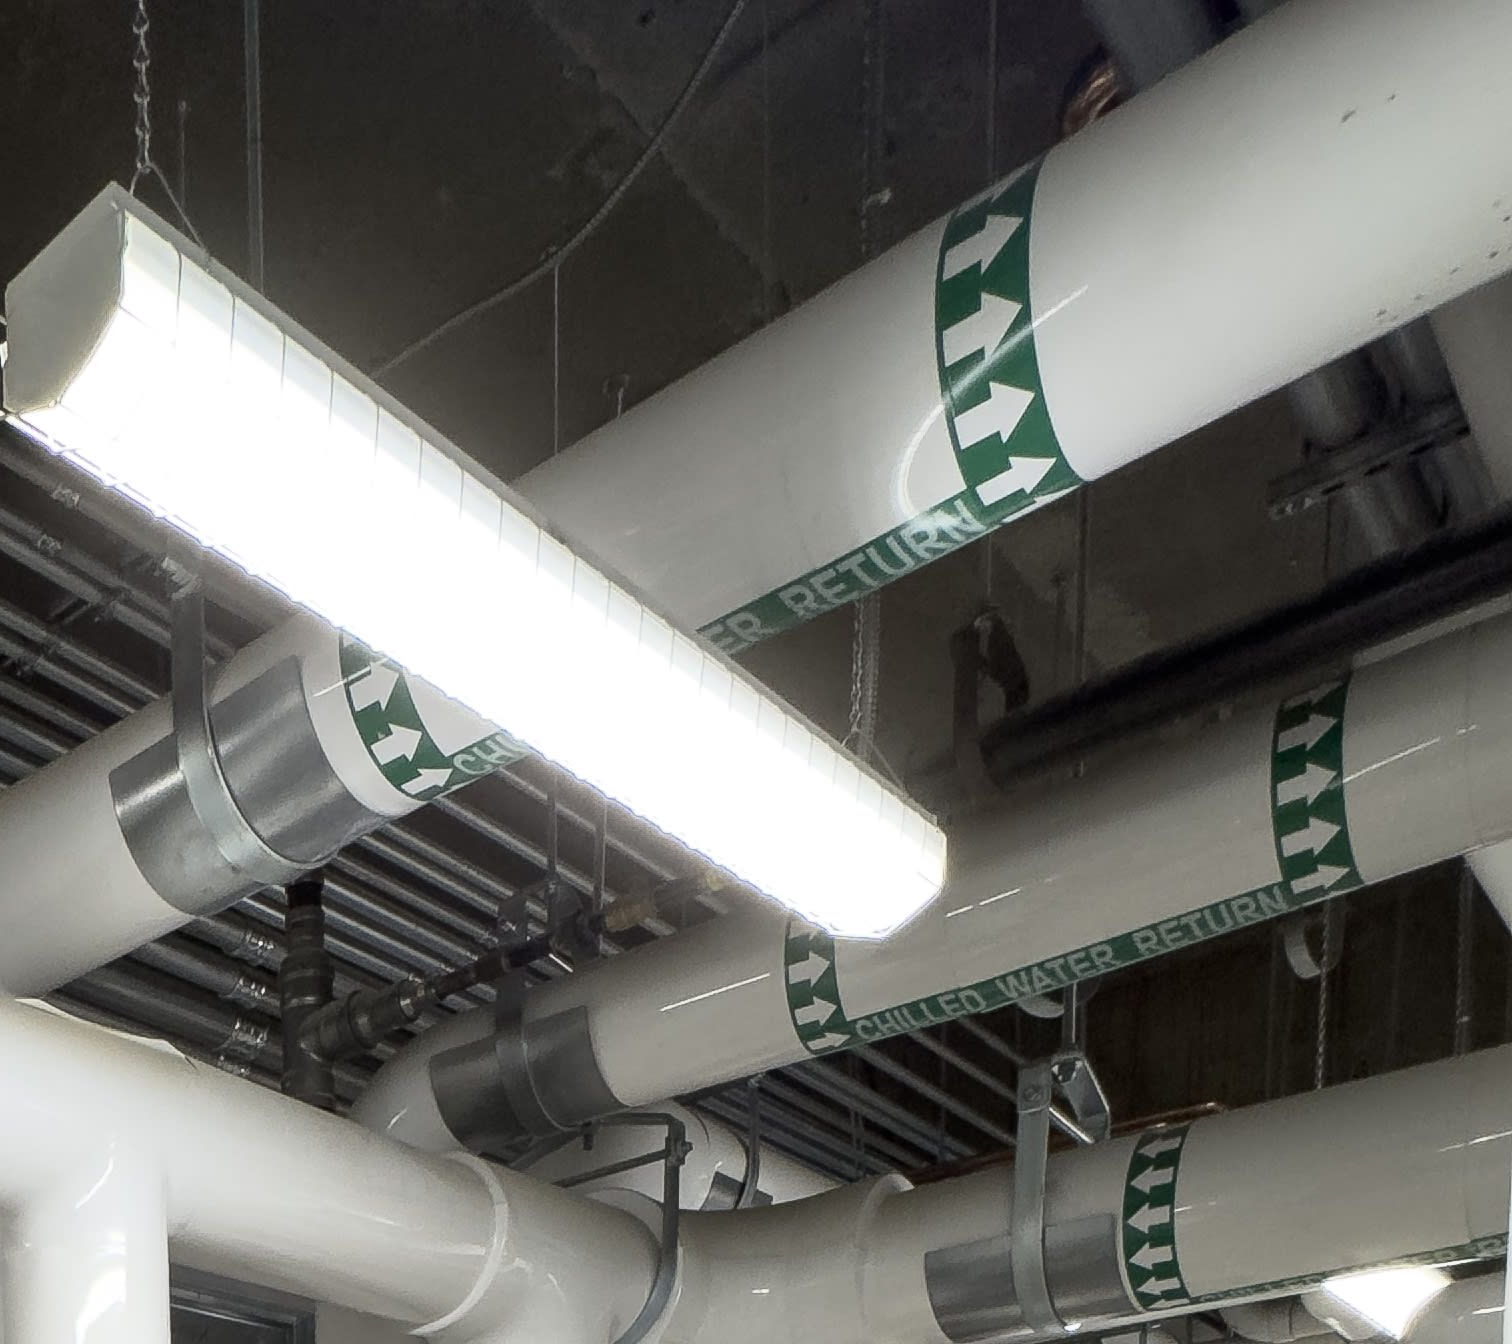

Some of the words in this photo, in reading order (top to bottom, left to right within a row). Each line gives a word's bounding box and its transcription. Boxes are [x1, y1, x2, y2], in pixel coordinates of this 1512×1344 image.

[778, 498, 987, 620] RETURN
[856, 990, 987, 1041] CHILLED
[996, 943, 1121, 998] WATER
[1131, 886, 1288, 957] RETURN
